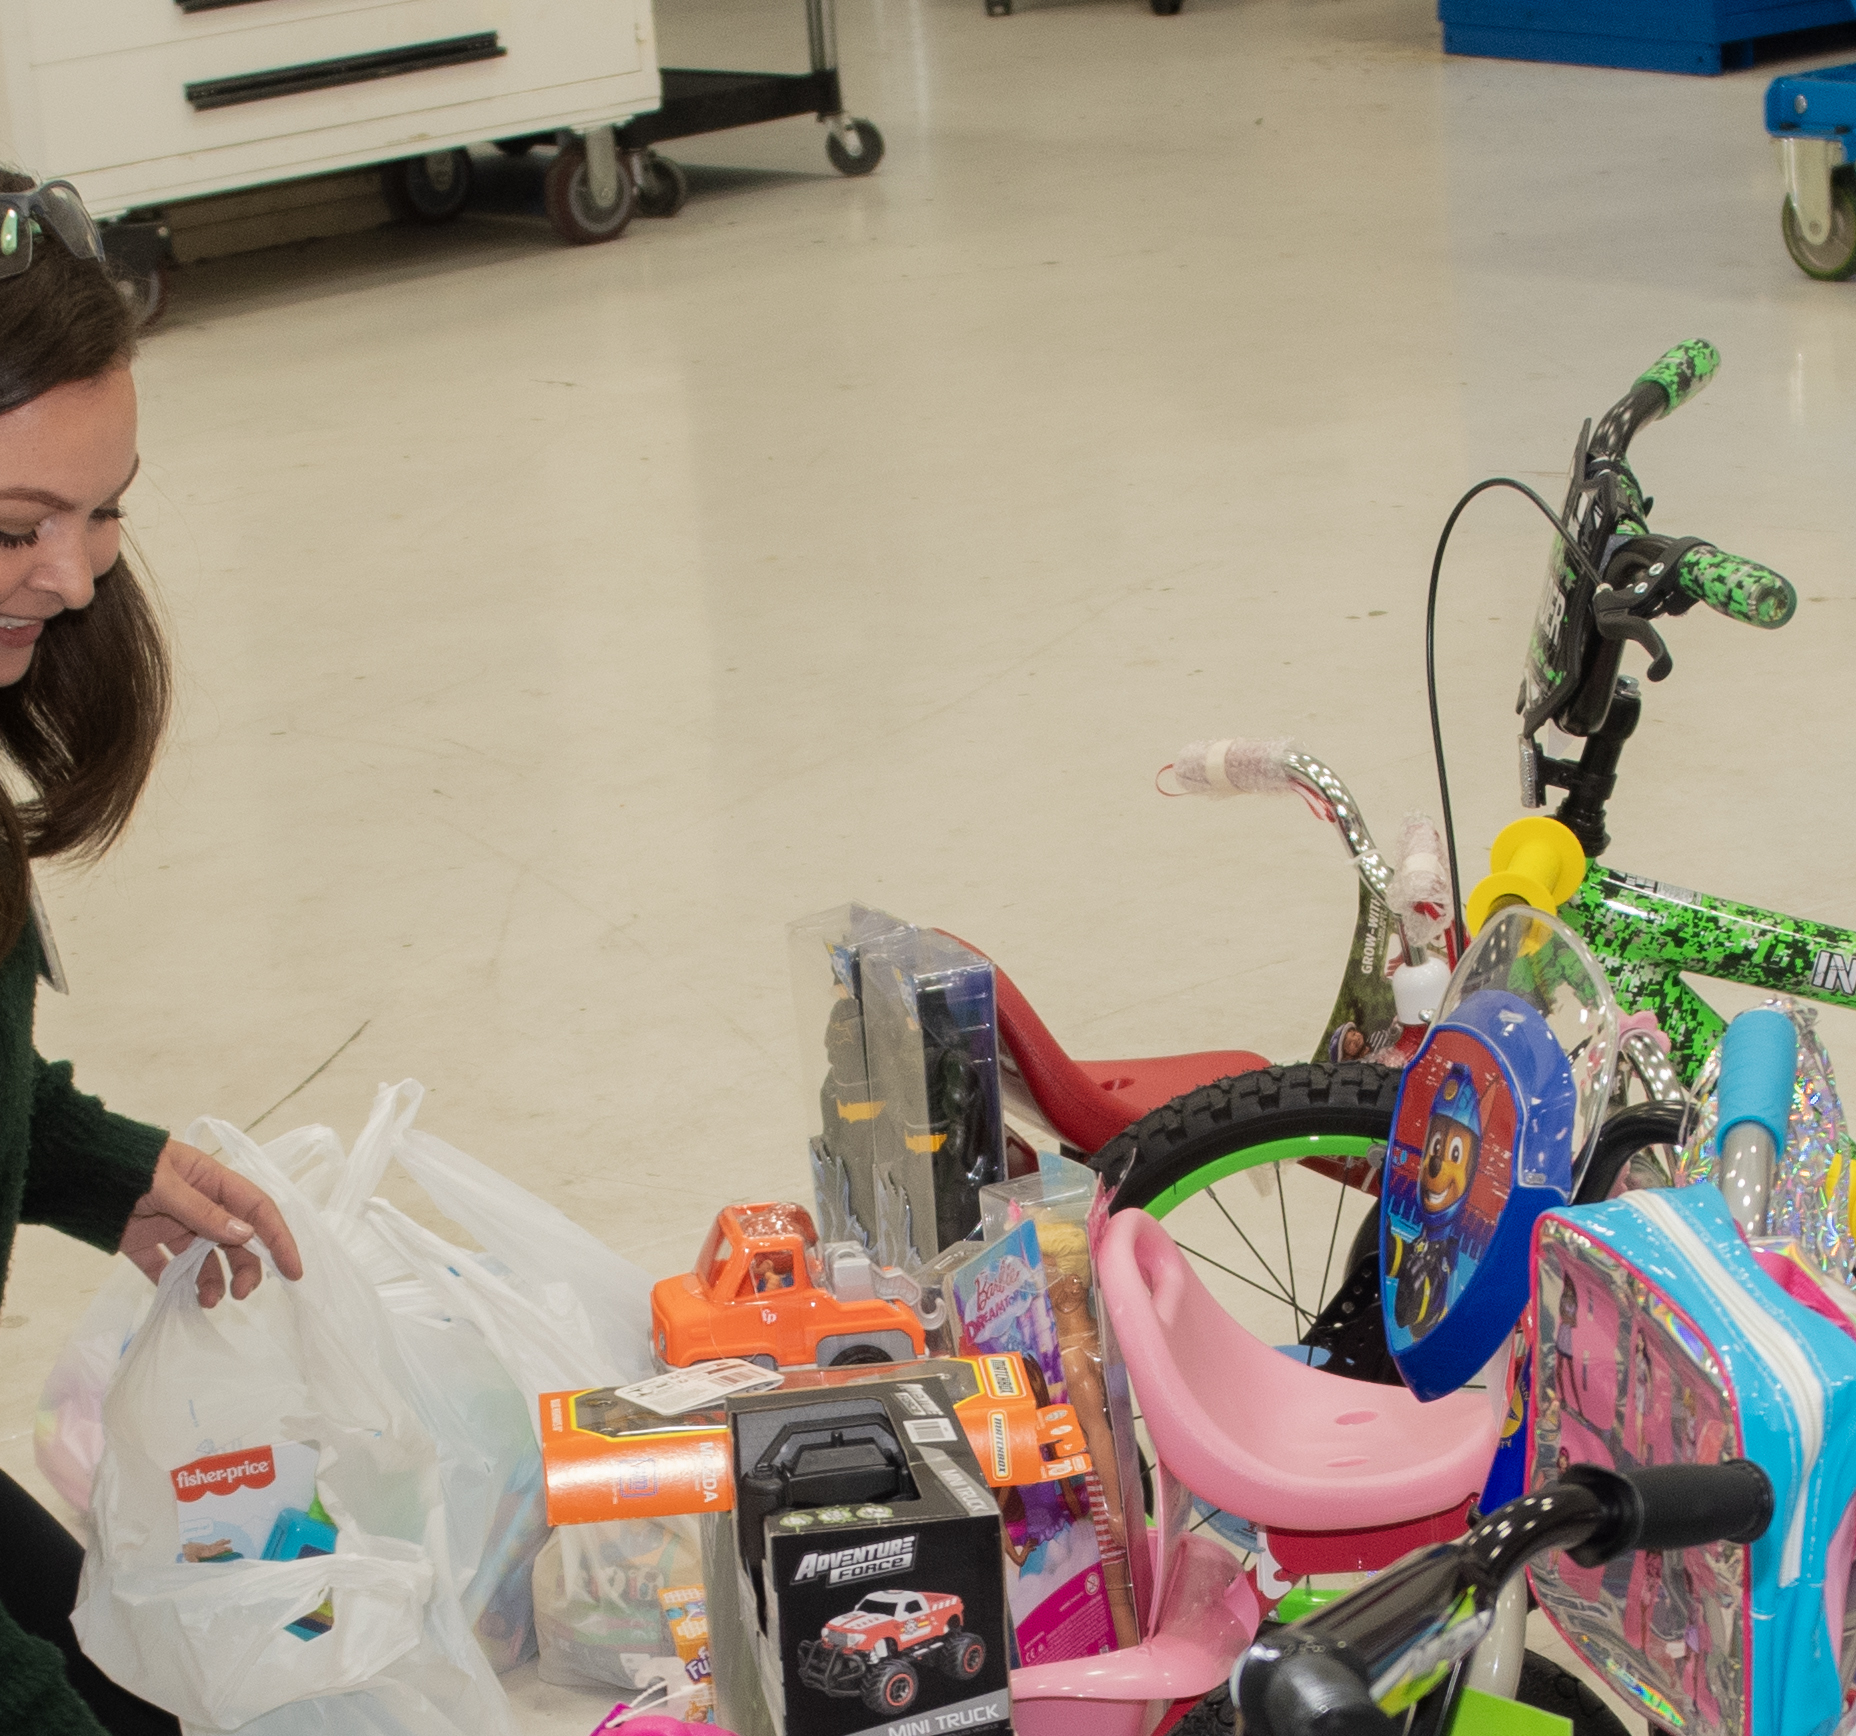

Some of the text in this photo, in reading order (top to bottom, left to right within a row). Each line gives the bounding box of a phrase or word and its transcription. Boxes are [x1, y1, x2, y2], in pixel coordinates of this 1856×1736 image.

[973, 1258, 1020, 1313] Barbie
[993, 1413, 1008, 1477] MATCHBOX
[175, 1453, 270, 1493] fisher-price
[790, 1534, 919, 1581] ADVENTURE
[836, 1555, 906, 1579] FORCE
[933, 1703, 1000, 1730] TRUCK
